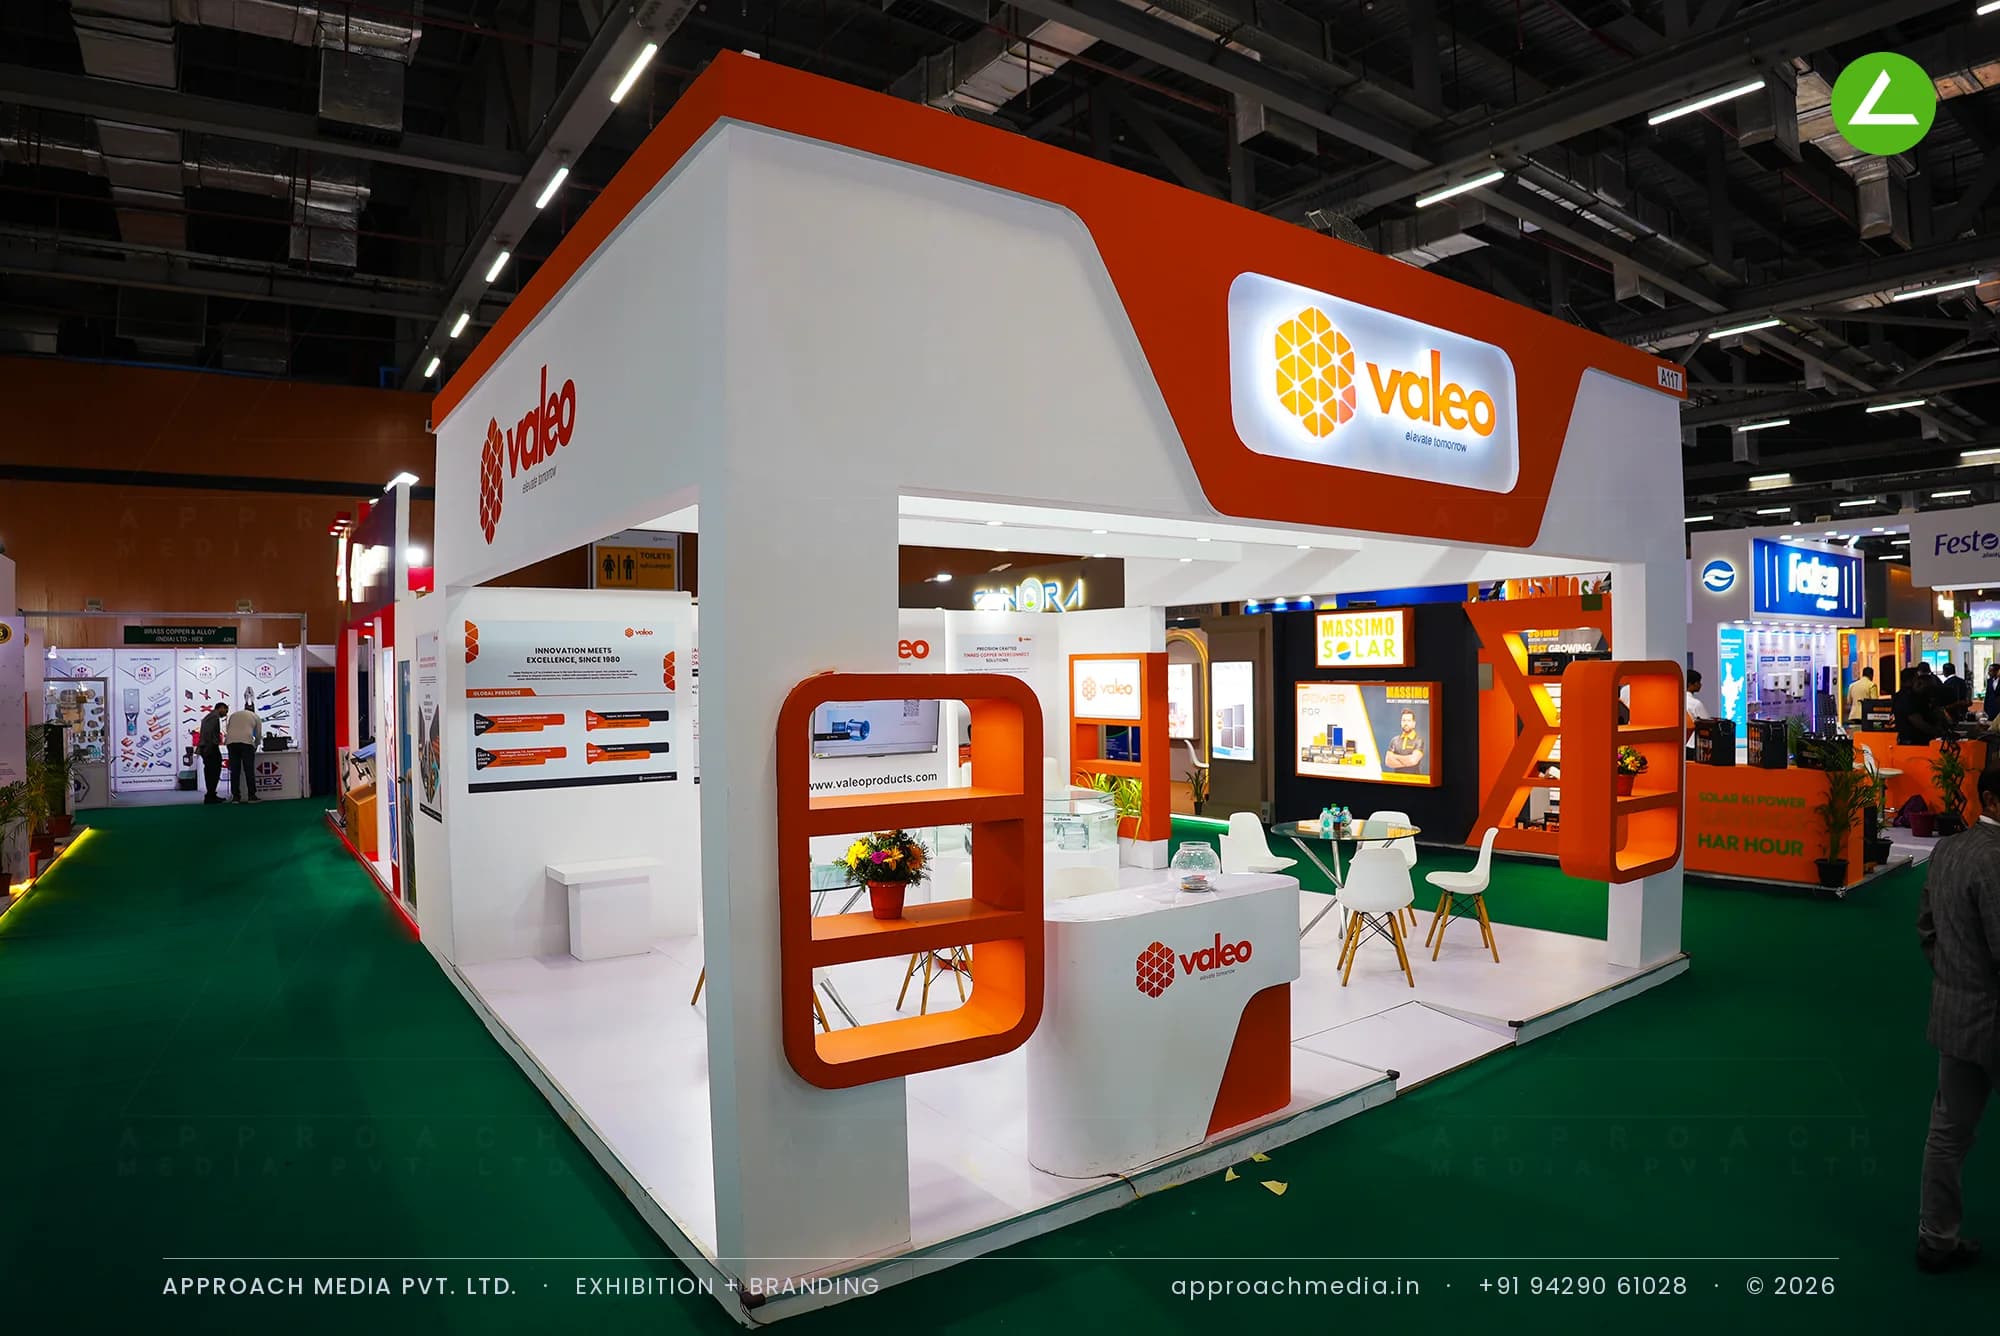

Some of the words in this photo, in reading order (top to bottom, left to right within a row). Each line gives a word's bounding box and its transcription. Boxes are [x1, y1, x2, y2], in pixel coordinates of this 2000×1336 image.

[1660, 368, 1679, 389] A117
[1366, 349, 1496, 437] valeo
[506, 363, 576, 479] valeo
[1433, 436, 1467, 453] tomorrow
[640, 551, 672, 560] TOILETS
[634, 628, 653, 636] valeo
[1322, 616, 1394, 638] MASSIMO
[535, 647, 586, 655] INNOVATION
[1323, 639, 1396, 660] SOLAR
[1548, 643, 1592, 654] GROWING
[526, 655, 577, 664] EXCELLENCE,
[578, 655, 602, 663] SINCE
[603, 655, 620, 663] 1980
[1100, 677, 1133, 696] valeo
[1386, 686, 1429, 699] MASSIMO
[1302, 693, 1345, 705] POWER
[1699, 791, 1738, 804] SOLAR
[1757, 795, 1806, 808] POWER
[1697, 832, 1739, 852] HAR
[1743, 836, 1804, 856] HOUR
[1178, 932, 1253, 976] valeo
